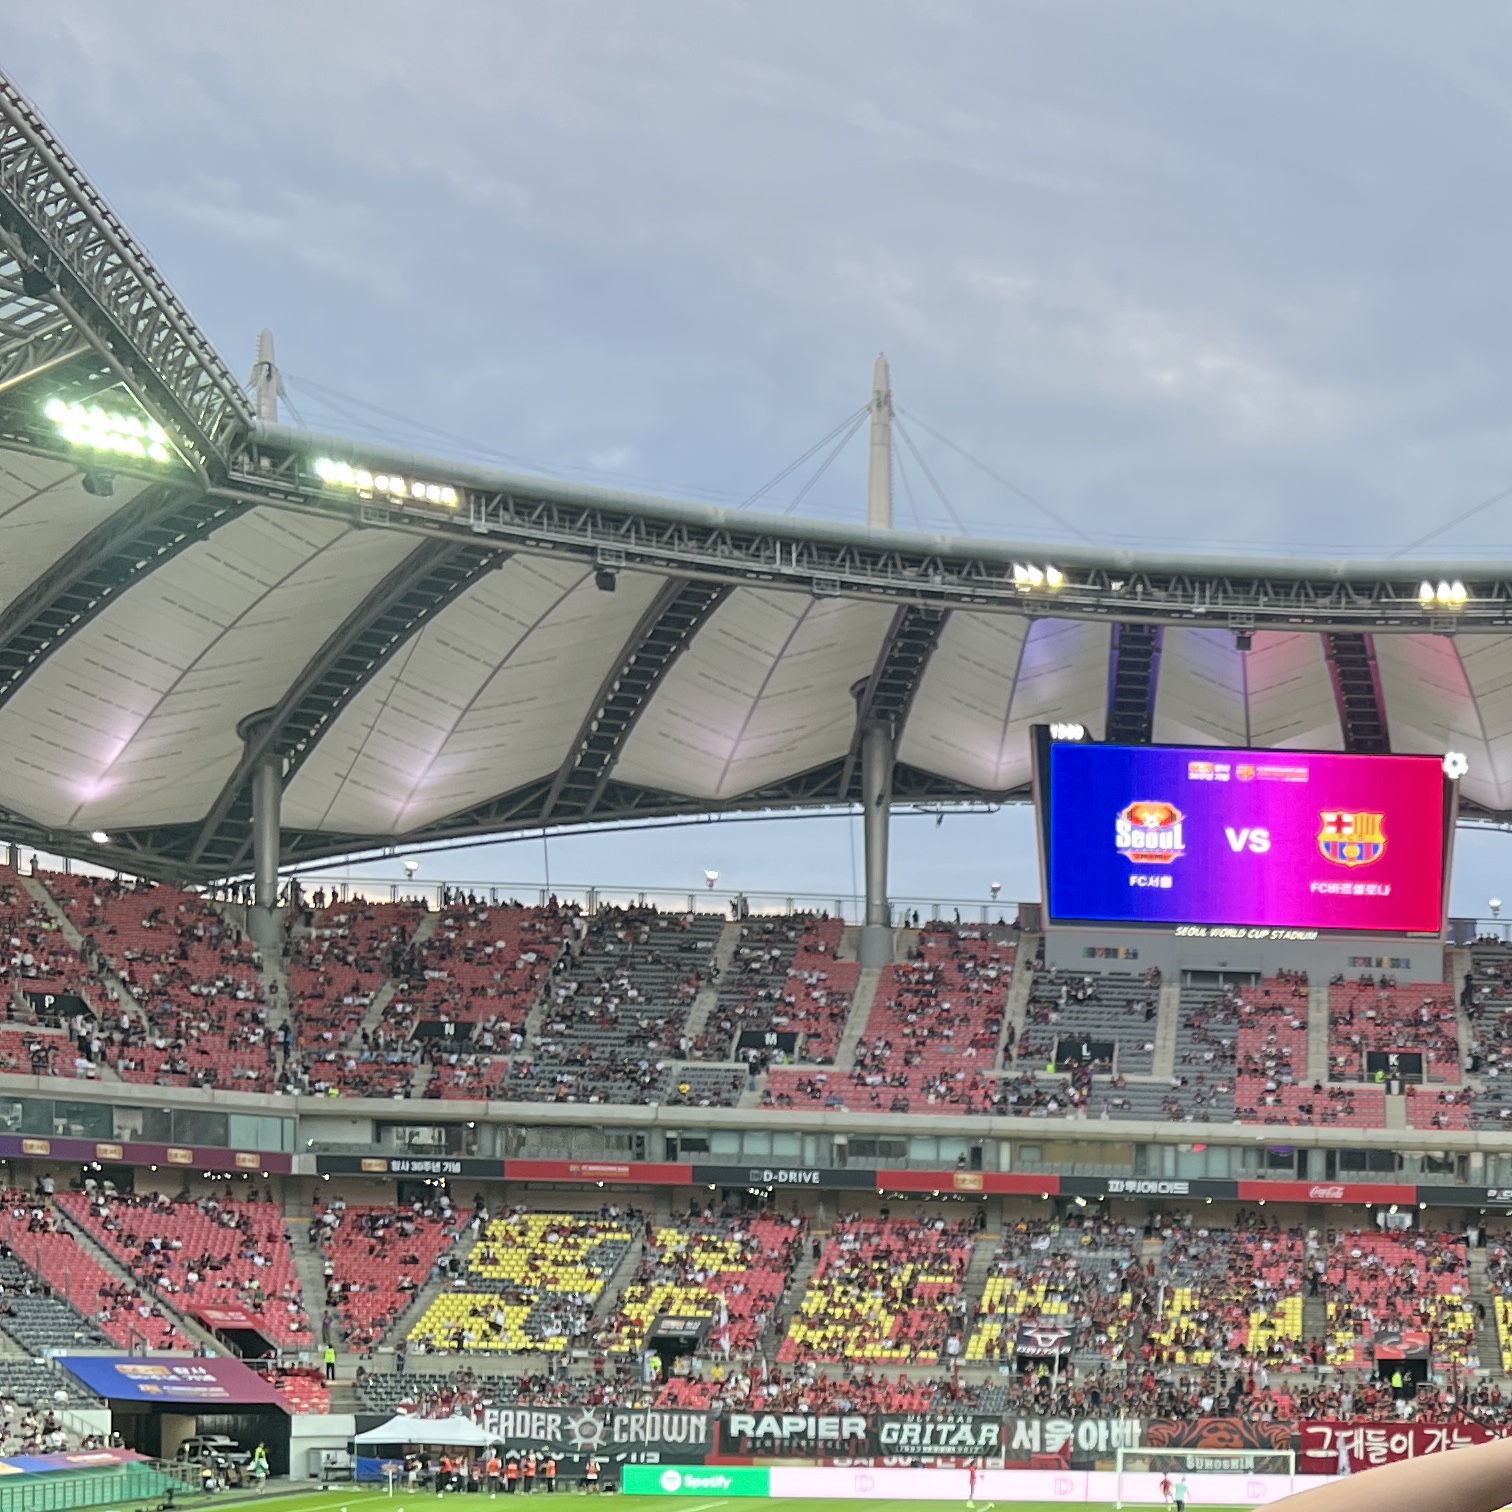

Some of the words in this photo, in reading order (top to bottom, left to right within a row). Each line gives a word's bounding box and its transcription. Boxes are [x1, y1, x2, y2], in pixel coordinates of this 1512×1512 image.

[1225, 827, 1271, 853] VS
[1175, 927, 1207, 937] SEOUL
[1210, 928, 1247, 938] WORLD
[1247, 929, 1270, 939] CUP
[1270, 930, 1318, 940] STADIUM
[763, 1170, 820, 1184] D-DRIVE
[1108, 1180, 1189, 1194] 파워에이드
[483, 1411, 562, 1442] EADER
[613, 1412, 707, 1445] CROWN
[730, 1413, 867, 1439] RAPIER
[880, 1422, 999, 1446] GRITAR
[1306, 1426, 1414, 1464] 그대들이
[684, 1475, 732, 1490] Spotify
